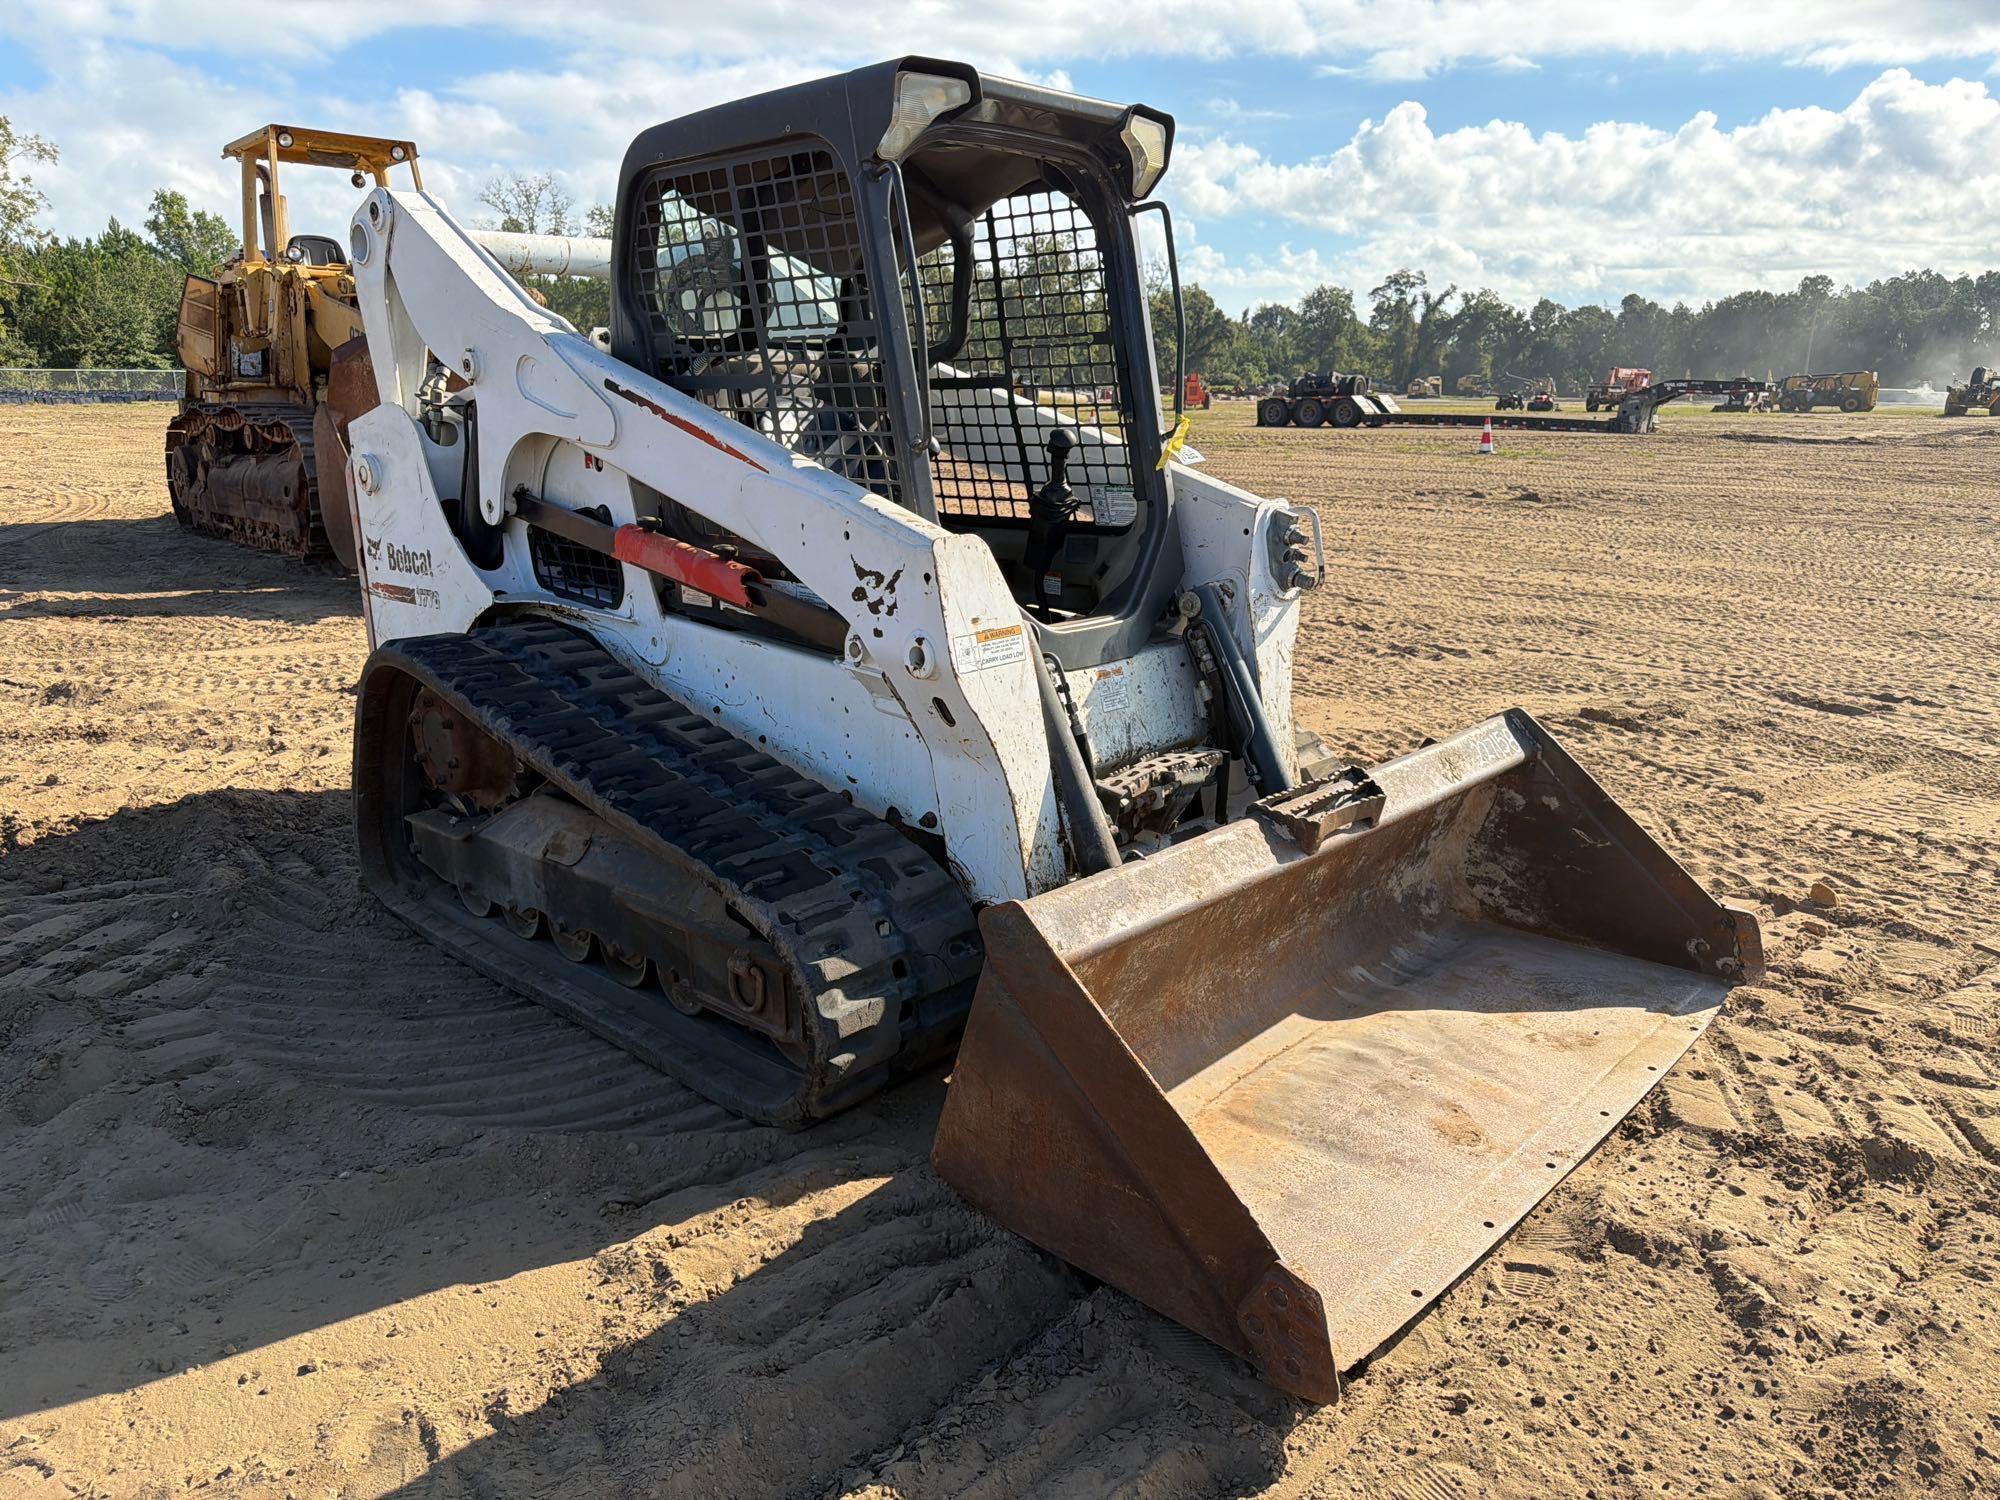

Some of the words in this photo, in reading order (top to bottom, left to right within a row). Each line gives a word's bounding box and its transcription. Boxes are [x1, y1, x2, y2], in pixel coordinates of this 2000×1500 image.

[387, 543, 434, 577] Bobcat
[990, 628, 1016, 639] WARNING
[981, 657, 999, 665] CARRY
[999, 652, 1013, 662] LOAD
[1013, 651, 1024, 659] LOW
